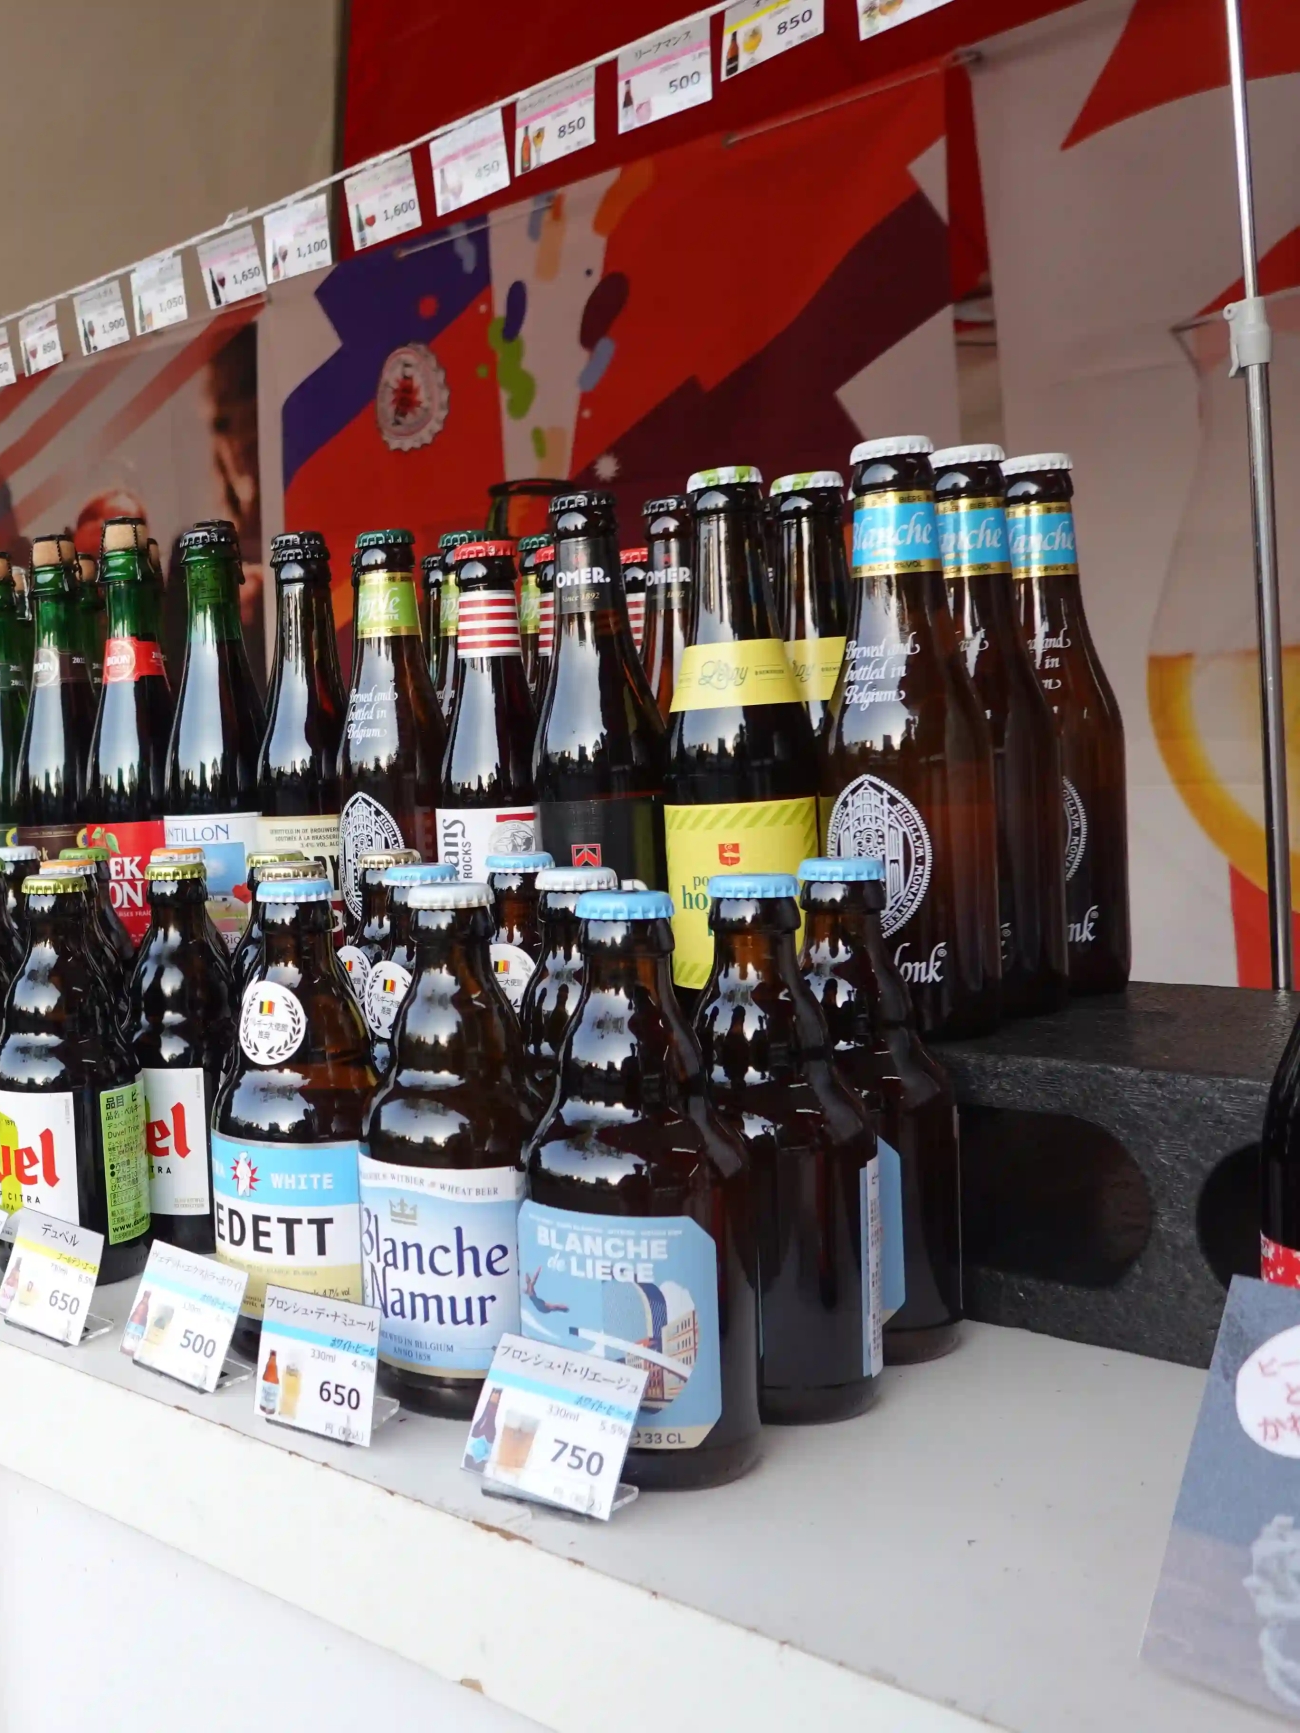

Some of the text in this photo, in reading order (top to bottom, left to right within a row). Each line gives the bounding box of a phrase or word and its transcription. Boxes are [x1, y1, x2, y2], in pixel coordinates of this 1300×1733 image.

[776, 8, 814, 36] 850
[668, 70, 701, 95] 500
[557, 116, 586, 140] 850
[383, 198, 416, 222] 1,600
[296, 238, 328, 259] 1,100
[232, 266, 262, 286] 1,650
[555, 566, 611, 589] OMER.
[845, 632, 920, 660] Brewed and
[844, 657, 906, 682] bottled in
[845, 681, 906, 711] Belgium
[377, 708, 387, 719] in
[347, 721, 387, 745] Belgium
[463, 841, 473, 879] ROCKS
[270, 1172, 334, 1190] WHITE
[390, 1172, 425, 1187] WITBIER
[439, 1183, 473, 1197] WHEAT
[475, 1186, 499, 1197] BEER
[7, 1192, 41, 1204] CITRA
[41, 1222, 80, 1248] デュベル
[361, 1206, 510, 1279] Blanche
[536, 1224, 669, 1260] BLANCHE
[547, 1250, 655, 1284] de LIEGE
[48, 1289, 80, 1315] 650
[368, 1260, 497, 1327] Namur
[179, 1328, 217, 1359] 500
[392, 1347, 414, 1358] ANNO
[404, 1338, 413, 1346] IN
[414, 1339, 454, 1353] BELGIUM
[310, 1347, 375, 1375] 330ml 4.5%
[499, 1344, 640, 1395] ブロンシュ・ド・リエージュ
[318, 1379, 361, 1412] 650
[645, 1432, 686, 1445] 33 CL
[550, 1437, 605, 1477] 750
